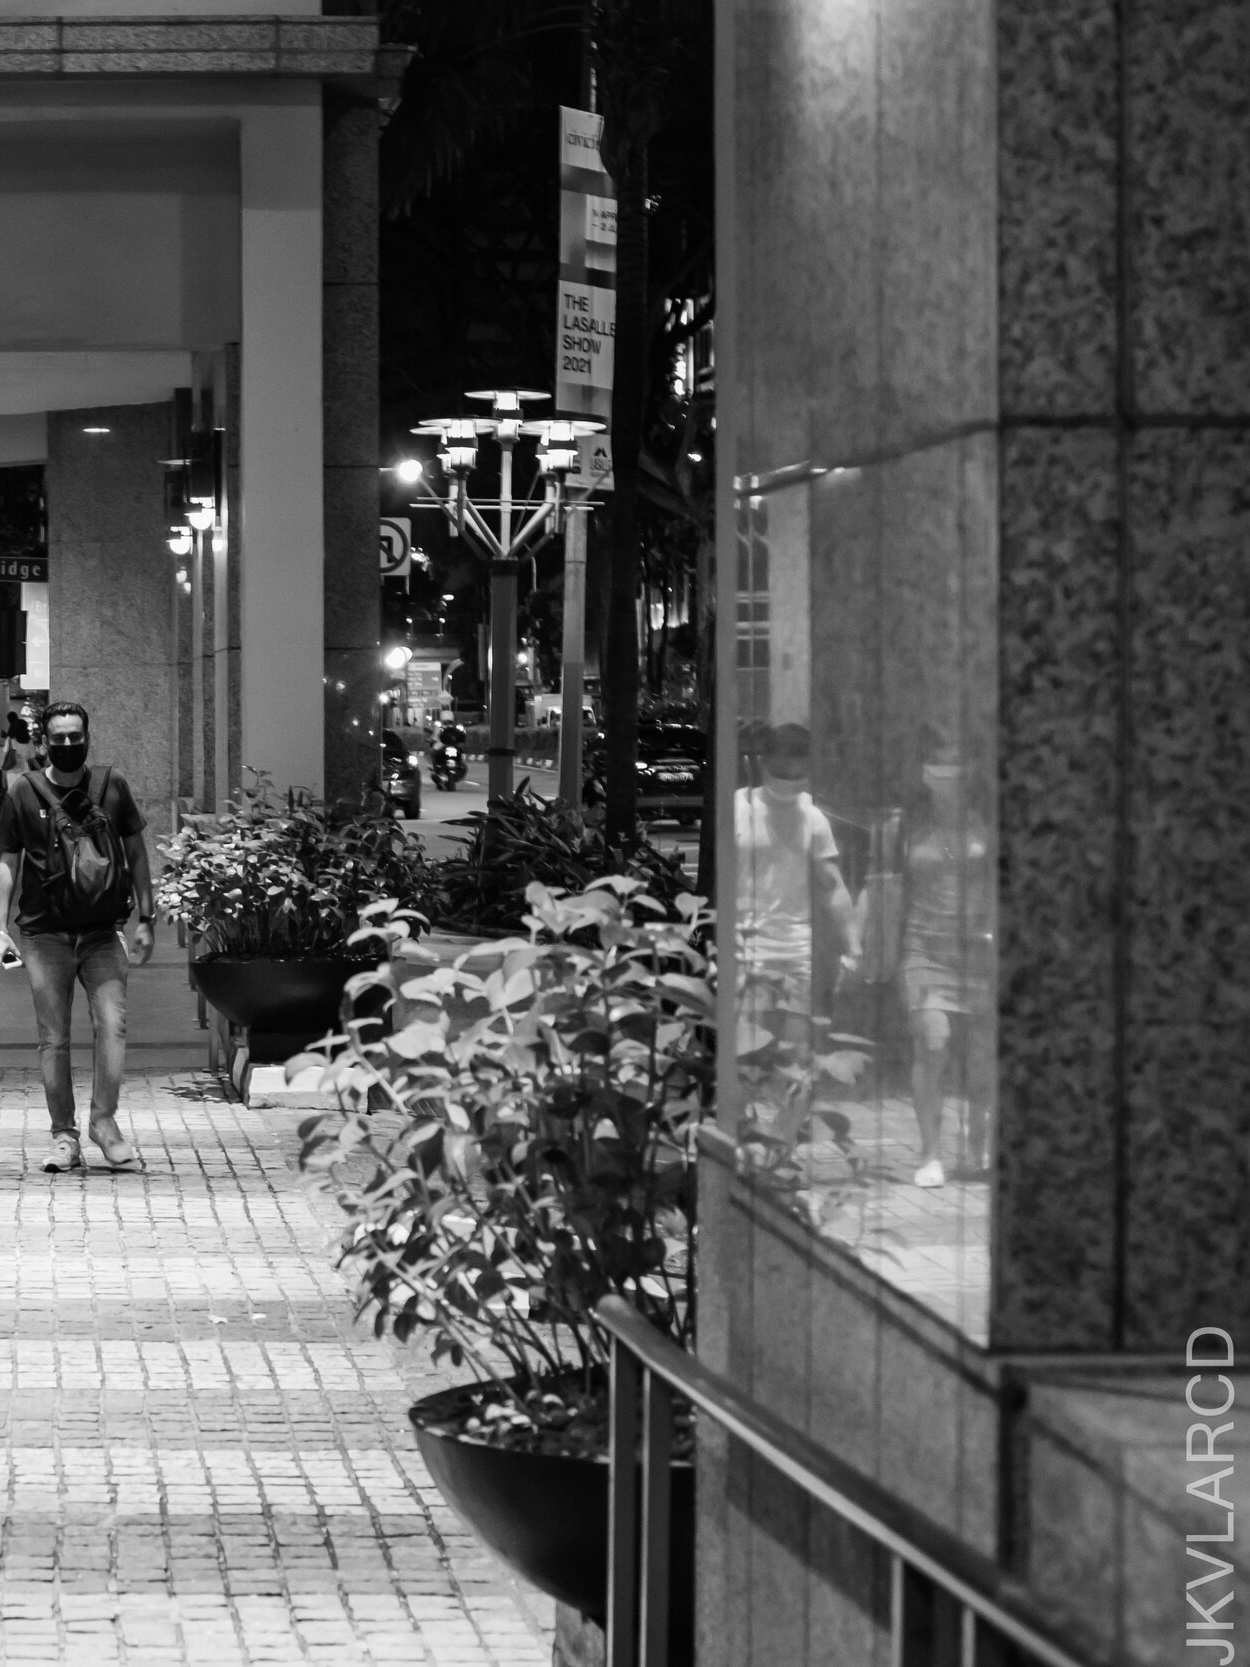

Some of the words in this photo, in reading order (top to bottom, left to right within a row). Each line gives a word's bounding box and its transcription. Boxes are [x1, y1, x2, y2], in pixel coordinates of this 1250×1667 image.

[563, 293, 589, 312] THE
[563, 314, 616, 338] LASALLE
[563, 334, 602, 355] SHOW
[563, 355, 592, 374] 2021
